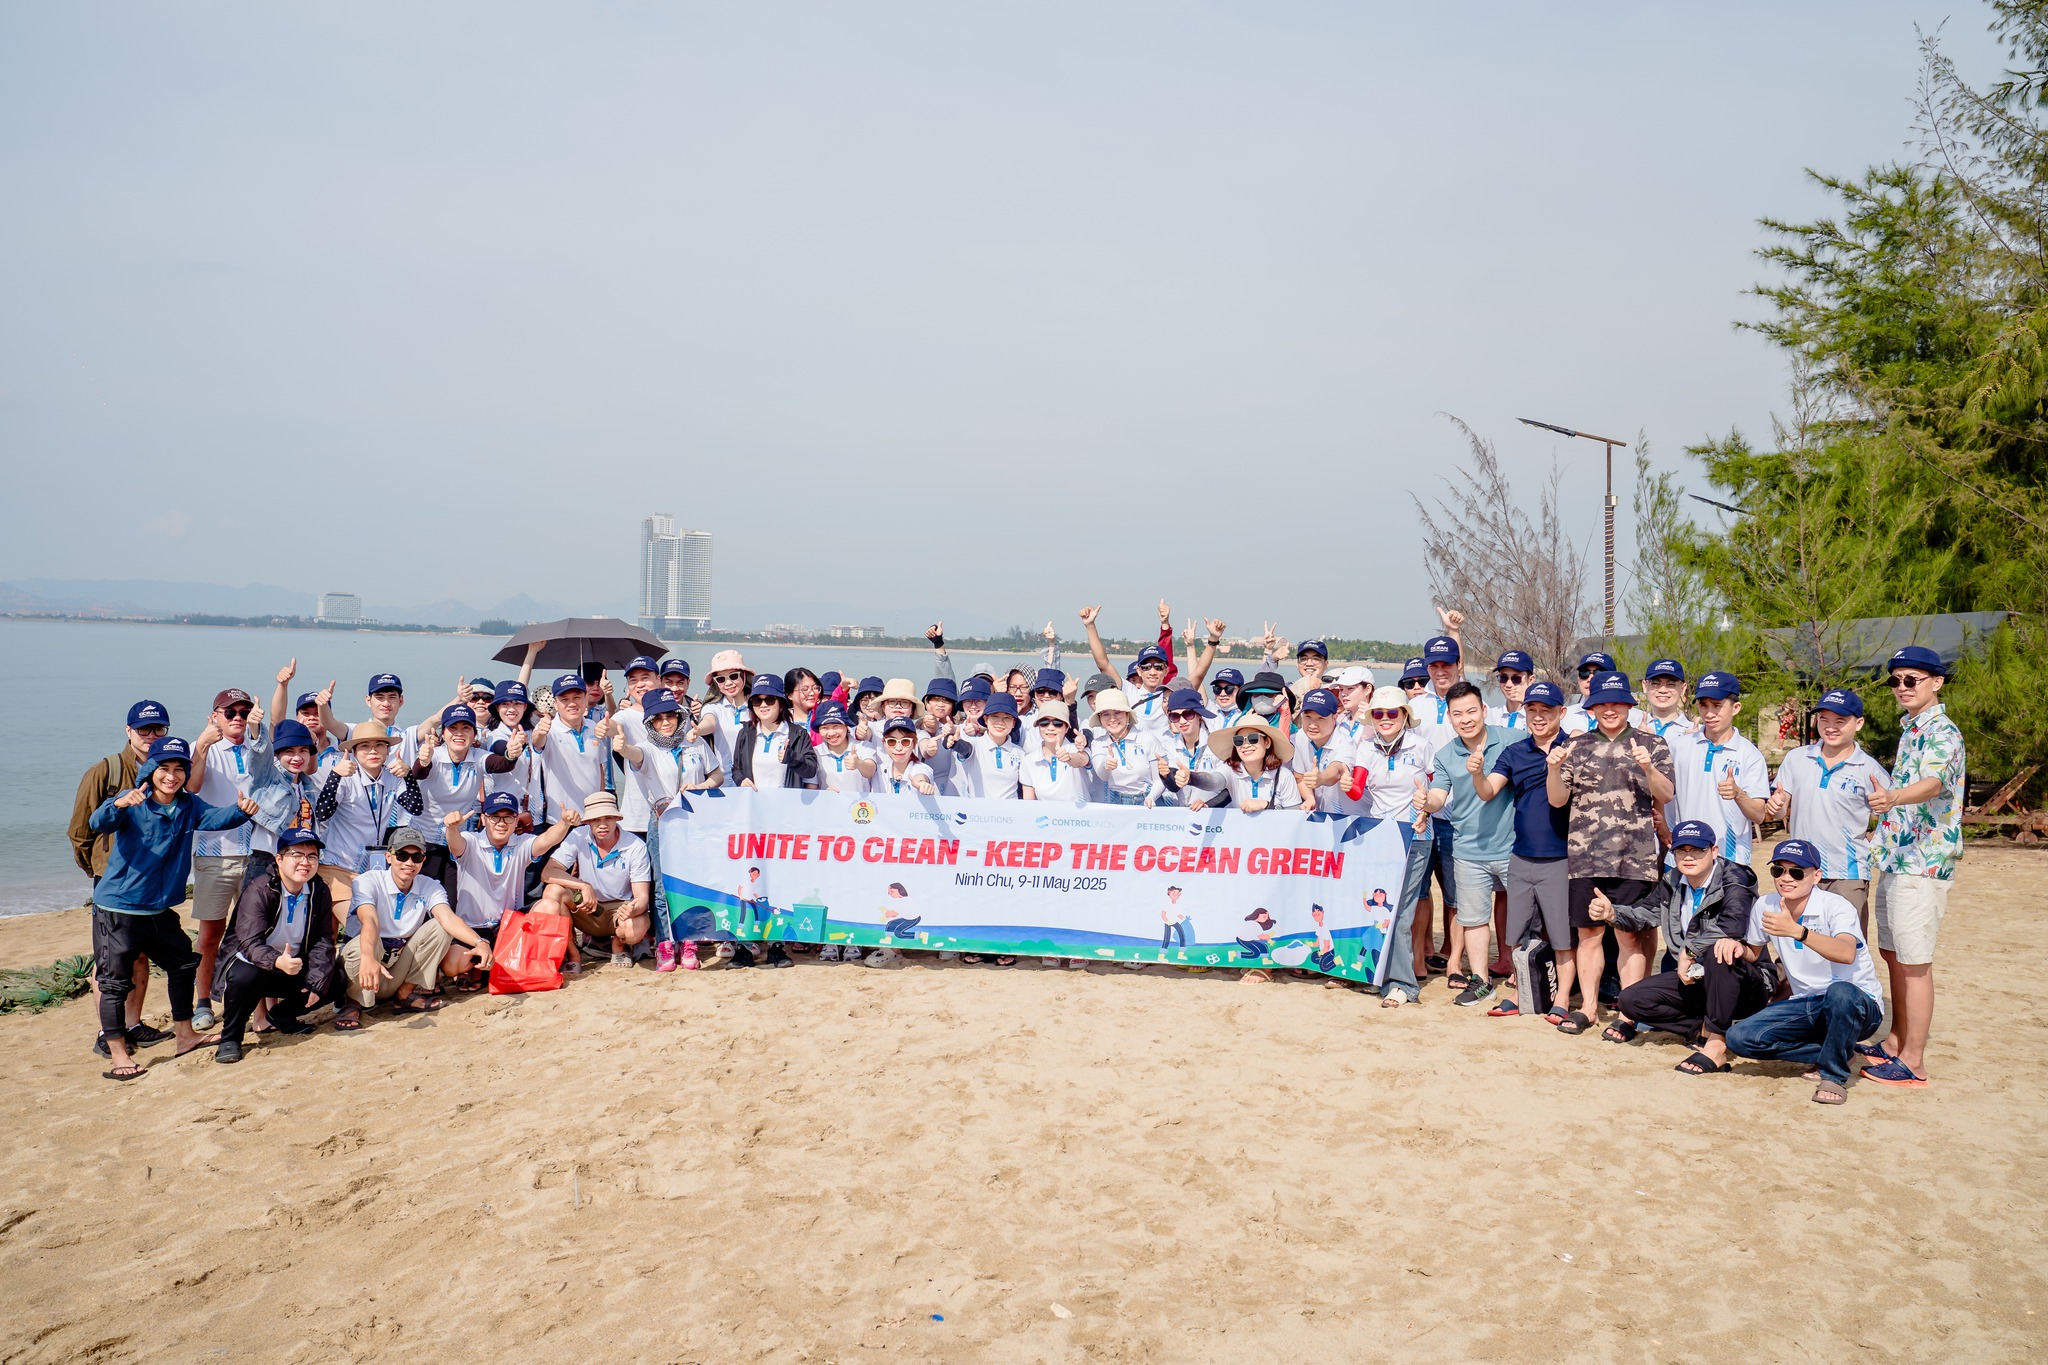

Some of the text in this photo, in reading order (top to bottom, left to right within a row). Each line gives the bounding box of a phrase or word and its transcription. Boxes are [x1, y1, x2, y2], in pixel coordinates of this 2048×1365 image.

[909, 812, 1014, 824] PETERSON SOLUTIONS
[1137, 823, 1185, 832] PETERSON
[727, 832, 810, 862] UNITE
[817, 834, 856, 863] TO
[862, 837, 960, 866] CLEAN
[983, 840, 1063, 869] KEEP
[1070, 843, 1129, 872] THE
[1133, 845, 1241, 875] OCEAN
[1247, 848, 1345, 880] GREEN
[955, 873, 1107, 892] Ninh Chu, 9-11 May 2025
